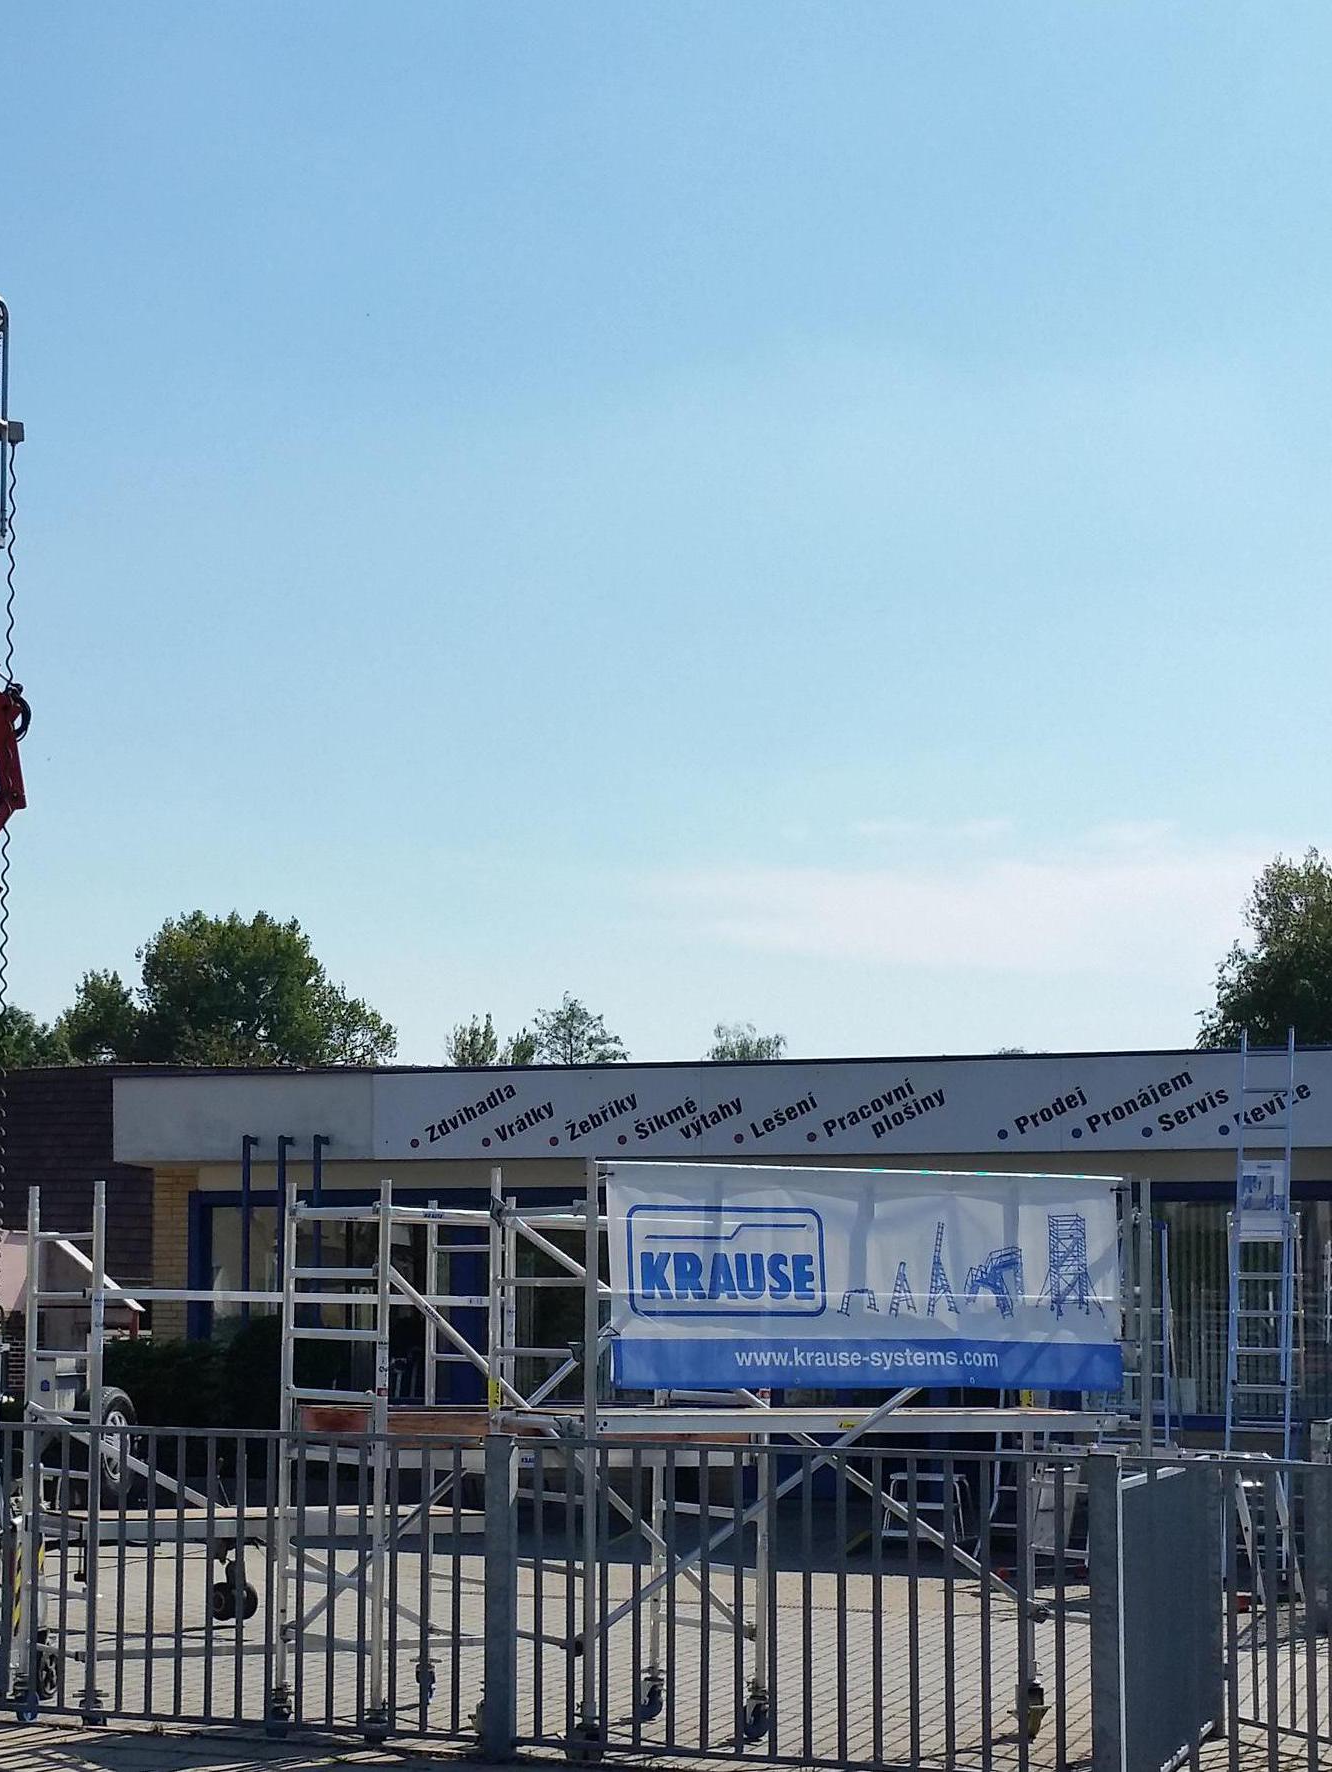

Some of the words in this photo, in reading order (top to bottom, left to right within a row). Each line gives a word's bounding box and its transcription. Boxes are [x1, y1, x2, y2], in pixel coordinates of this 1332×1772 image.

[424, 1083, 517, 1144] Zdvihadla
[494, 1101, 554, 1144] Vrátky
[565, 1091, 638, 1142] Žebříky
[634, 1096, 698, 1141] Šikmé
[679, 1096, 743, 1142] výtahy
[749, 1091, 818, 1139] Lešení
[822, 1077, 916, 1138] Pracovní
[870, 1086, 946, 1139] plošiny
[1014, 1086, 1088, 1136] Prodej
[1085, 1071, 1194, 1134] Pronájem
[1157, 1088, 1229, 1132] Servis
[640, 1251, 815, 1301] KRAUSE
[735, 1347, 998, 1369] www.krause-systems.com
